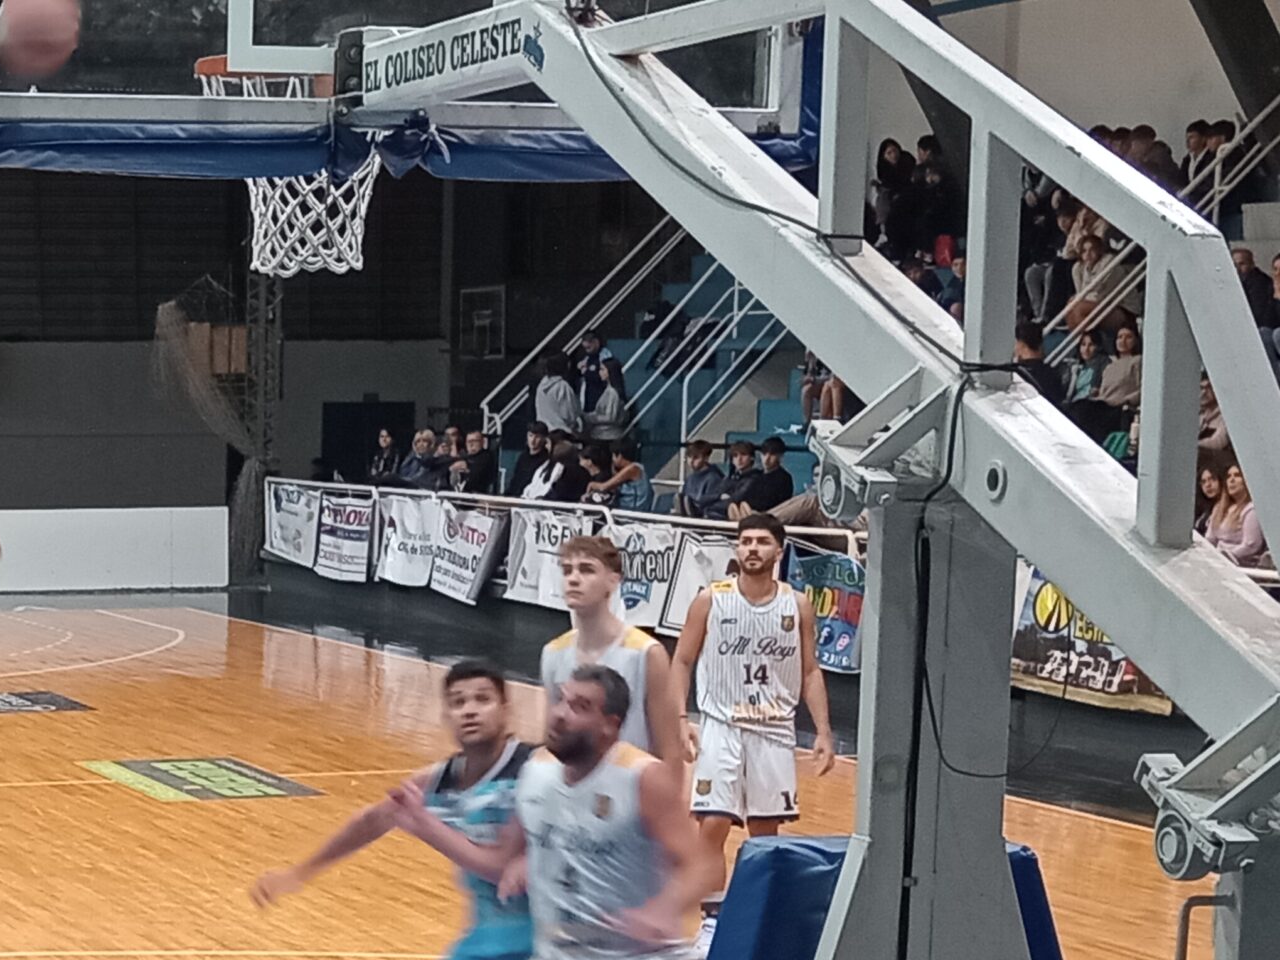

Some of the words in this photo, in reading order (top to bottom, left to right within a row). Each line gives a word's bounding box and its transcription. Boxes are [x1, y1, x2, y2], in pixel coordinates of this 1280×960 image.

[365, 59, 382, 93] EL
[385, 40, 446, 88] COLISEO
[450, 18, 521, 71] CELESTE
[718, 636, 747, 656] All
[753, 637, 797, 661] Boys
[744, 664, 769, 685] 14
